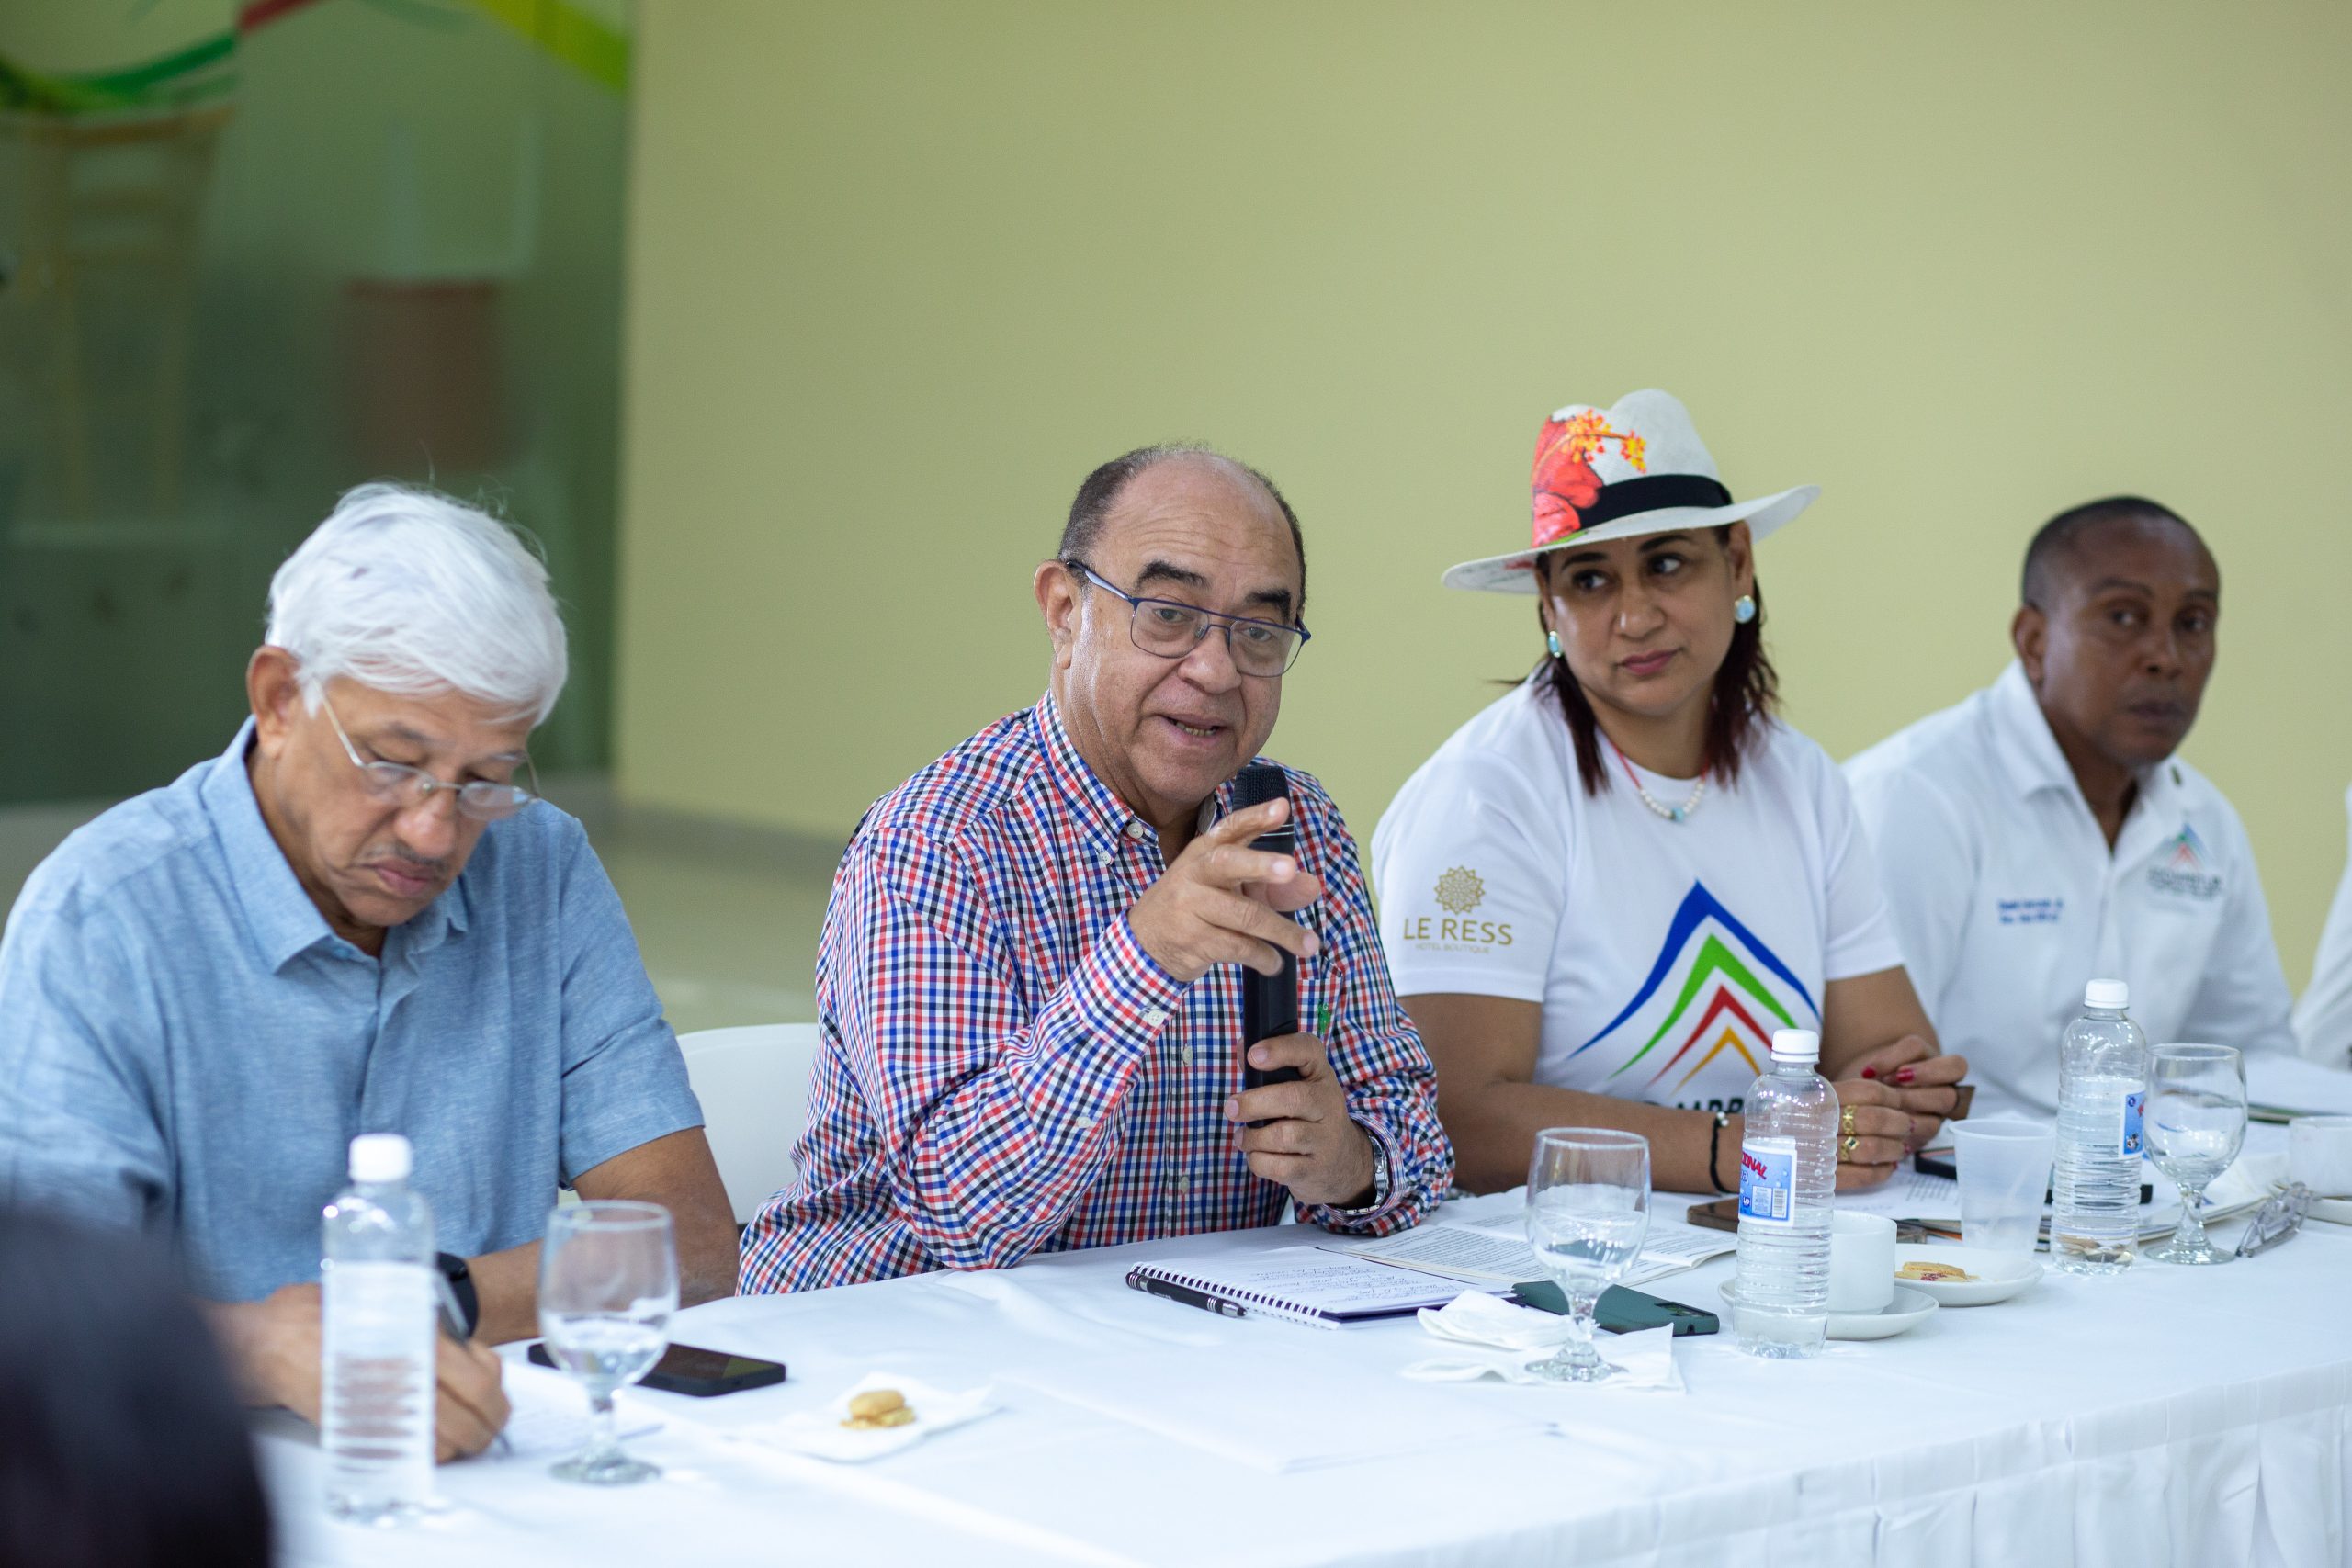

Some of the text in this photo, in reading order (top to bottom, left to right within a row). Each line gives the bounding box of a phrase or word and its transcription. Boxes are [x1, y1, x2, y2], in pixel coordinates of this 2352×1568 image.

[1403, 917, 1513, 945] LE RESS
[1415, 942, 1441, 951] HOTEL
